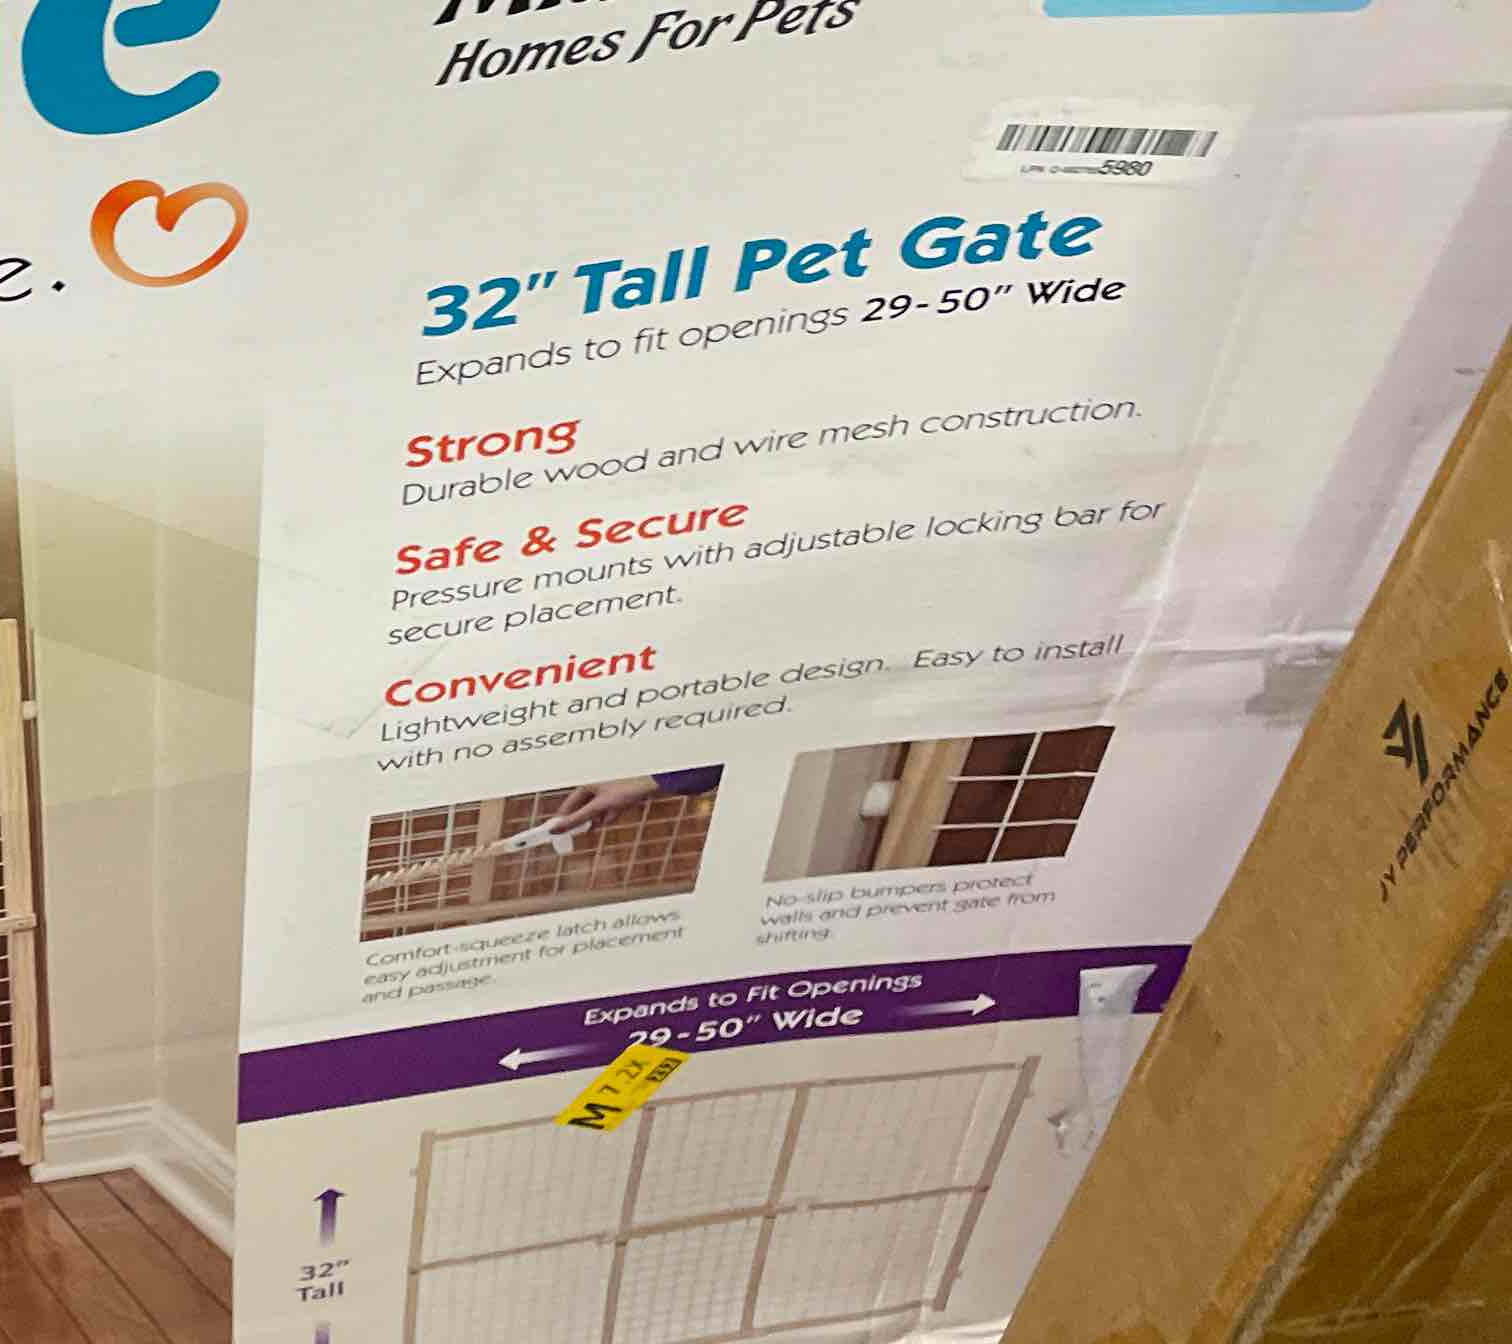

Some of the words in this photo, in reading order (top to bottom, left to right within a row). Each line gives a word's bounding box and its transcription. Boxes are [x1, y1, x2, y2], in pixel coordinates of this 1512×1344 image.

[434, 27, 626, 87] Homes
[629, 11, 733, 64] For
[421, 270, 558, 337] 32"
[573, 245, 710, 315] Tall
[733, 228, 872, 293] Pet
[900, 209, 1103, 270] Gate
[416, 341, 572, 385] Expands
[585, 337, 622, 360] to
[633, 327, 668, 354] fit
[678, 304, 849, 349] openings
[861, 284, 1013, 324] 29-50"
[1026, 277, 1127, 306] Wide
[402, 468, 533, 505] Durable
[543, 448, 648, 483] wood
[657, 437, 725, 467] and
[733, 428, 808, 457] wire
[819, 414, 909, 446] mesh
[920, 397, 1142, 435] construction.
[405, 418, 582, 468] Strong
[391, 573, 524, 612] Pressure
[533, 556, 654, 592] mounts
[664, 541, 734, 570] with
[743, 519, 915, 560] adjustable
[926, 511, 1044, 535] locking
[1054, 505, 1111, 527] bar
[1120, 500, 1167, 523] for
[395, 536, 502, 575] Safe
[521, 526, 557, 557] &
[575, 503, 750, 549] Secure
[388, 613, 503, 644] secure
[503, 585, 684, 633] placement.
[380, 699, 560, 744] Lightweight
[568, 688, 627, 714] and
[635, 671, 771, 708] portable
[780, 655, 889, 686] design.
[913, 648, 983, 671] Easy
[992, 643, 1025, 663] to
[1034, 633, 1124, 660] install
[385, 645, 657, 708] Convenient
[377, 746, 444, 772] with
[453, 742, 493, 762] no
[502, 714, 645, 754] assembly
[653, 696, 791, 732] required.
[1396, 666, 1509, 870] PERFORMANCE
[818, 903, 862, 921] and
[1006, 889, 1057, 906] from
[850, 881, 947, 901] bumpers
[951, 872, 1036, 893] protect
[556, 918, 608, 939] latch
[612, 908, 682, 928] allows
[363, 970, 411, 986] easy
[415, 948, 532, 979] adjustment
[538, 941, 566, 959] for
[572, 926, 686, 955] placement
[362, 986, 403, 1004] and
[584, 995, 699, 1027] Expands
[707, 989, 738, 1009] to
[745, 983, 779, 1003] Fit
[786, 973, 924, 999] Openings
[771, 1006, 864, 1032] Wide
[296, 1281, 345, 1303] Tall
[298, 1258, 351, 1282] 32"
